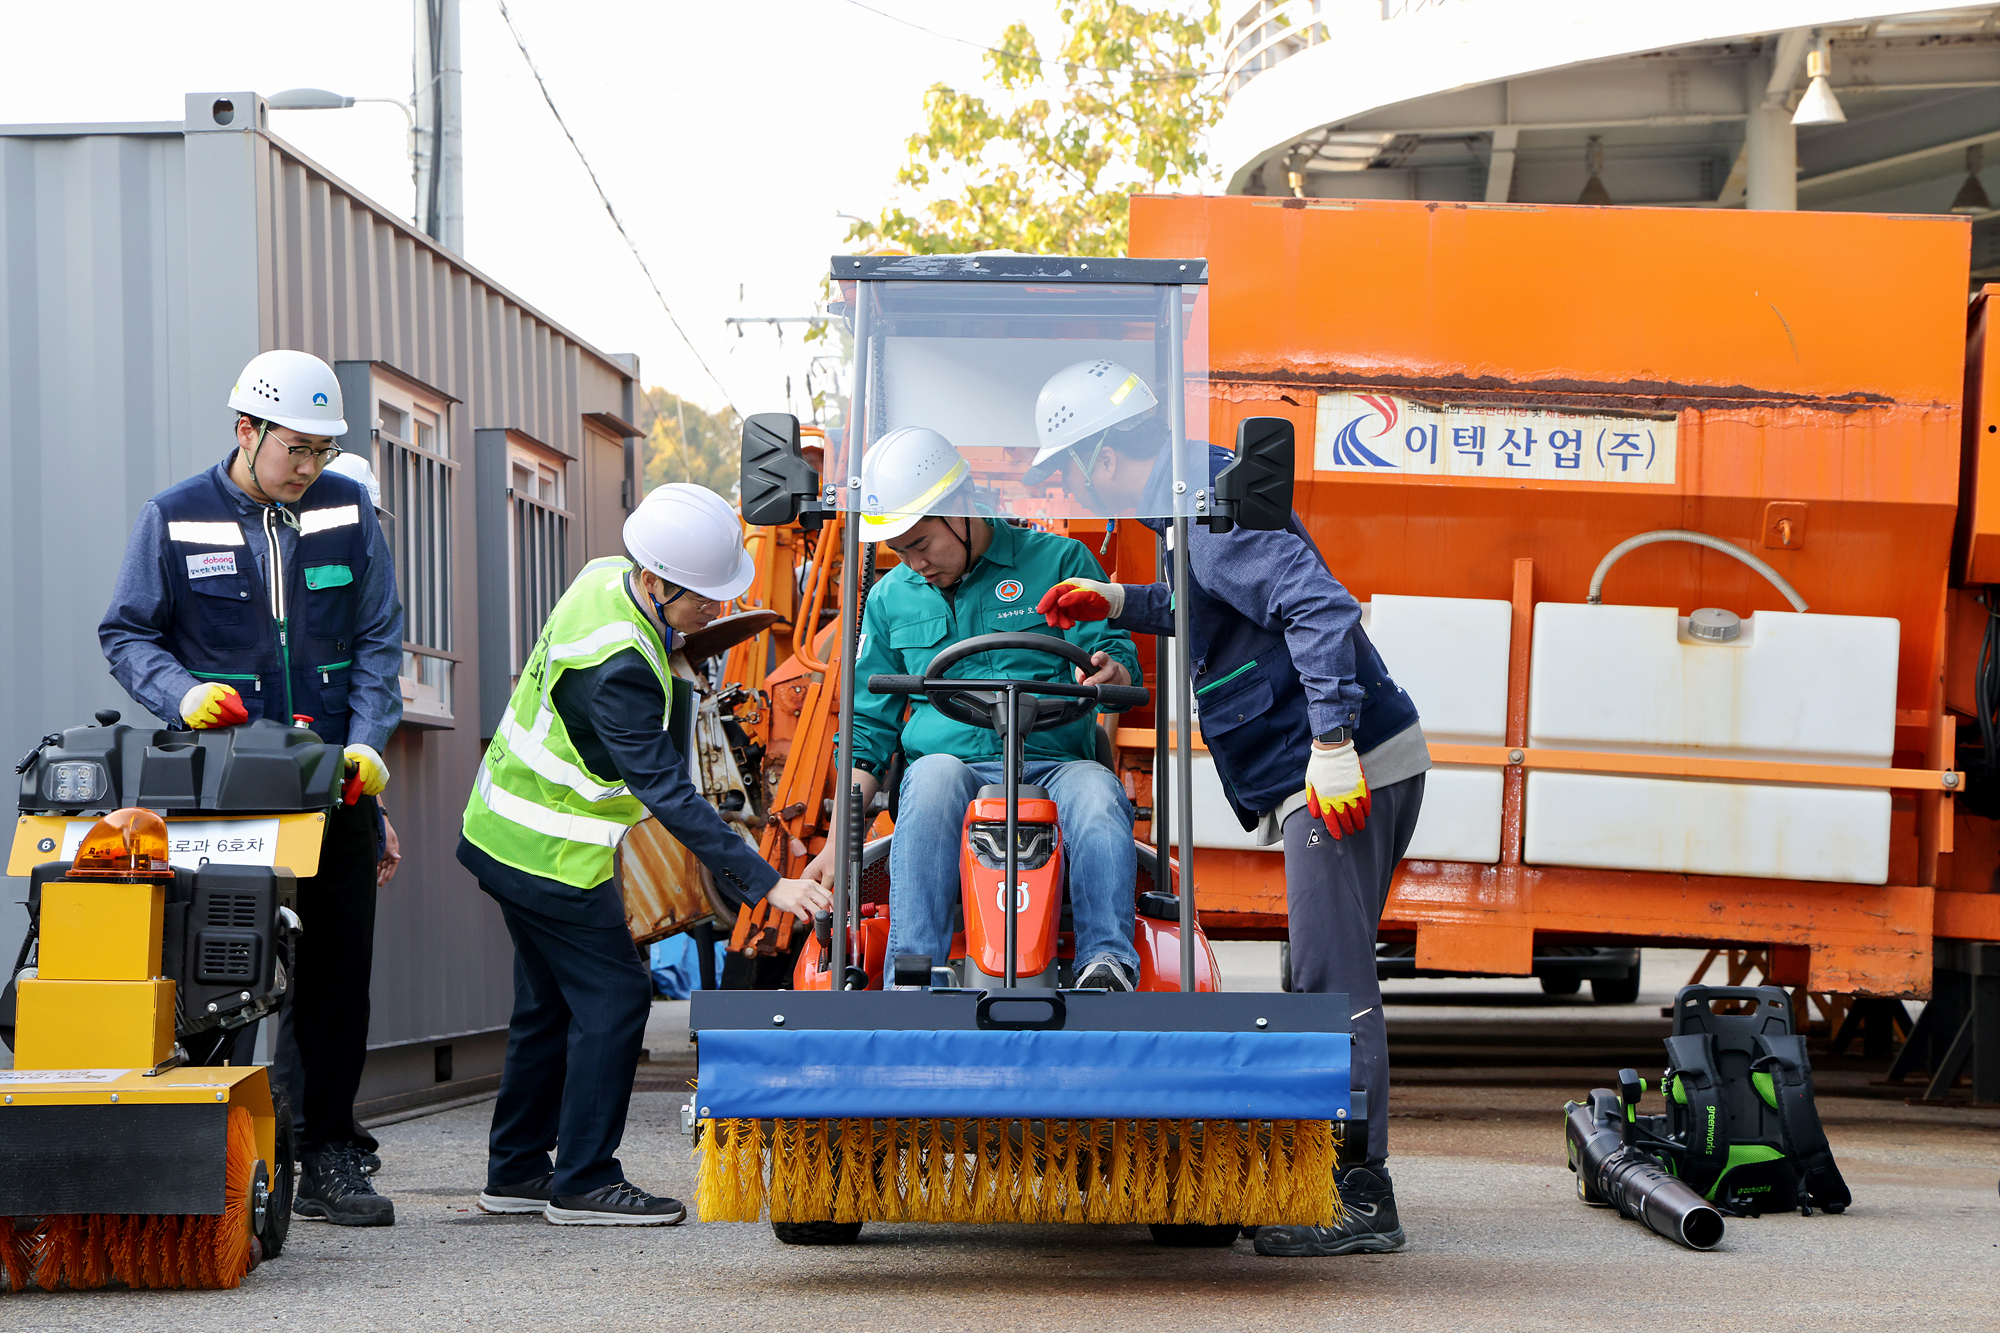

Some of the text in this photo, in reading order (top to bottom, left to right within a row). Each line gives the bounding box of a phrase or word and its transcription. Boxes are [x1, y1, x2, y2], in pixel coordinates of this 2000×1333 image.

[1405, 423, 1656, 472] 이텍산업(주)
[203, 556, 234, 565] dobong
[41, 840, 51, 850] 6
[217, 837, 264, 853] 6호차
[1705, 1105, 1716, 1156] greenworks
